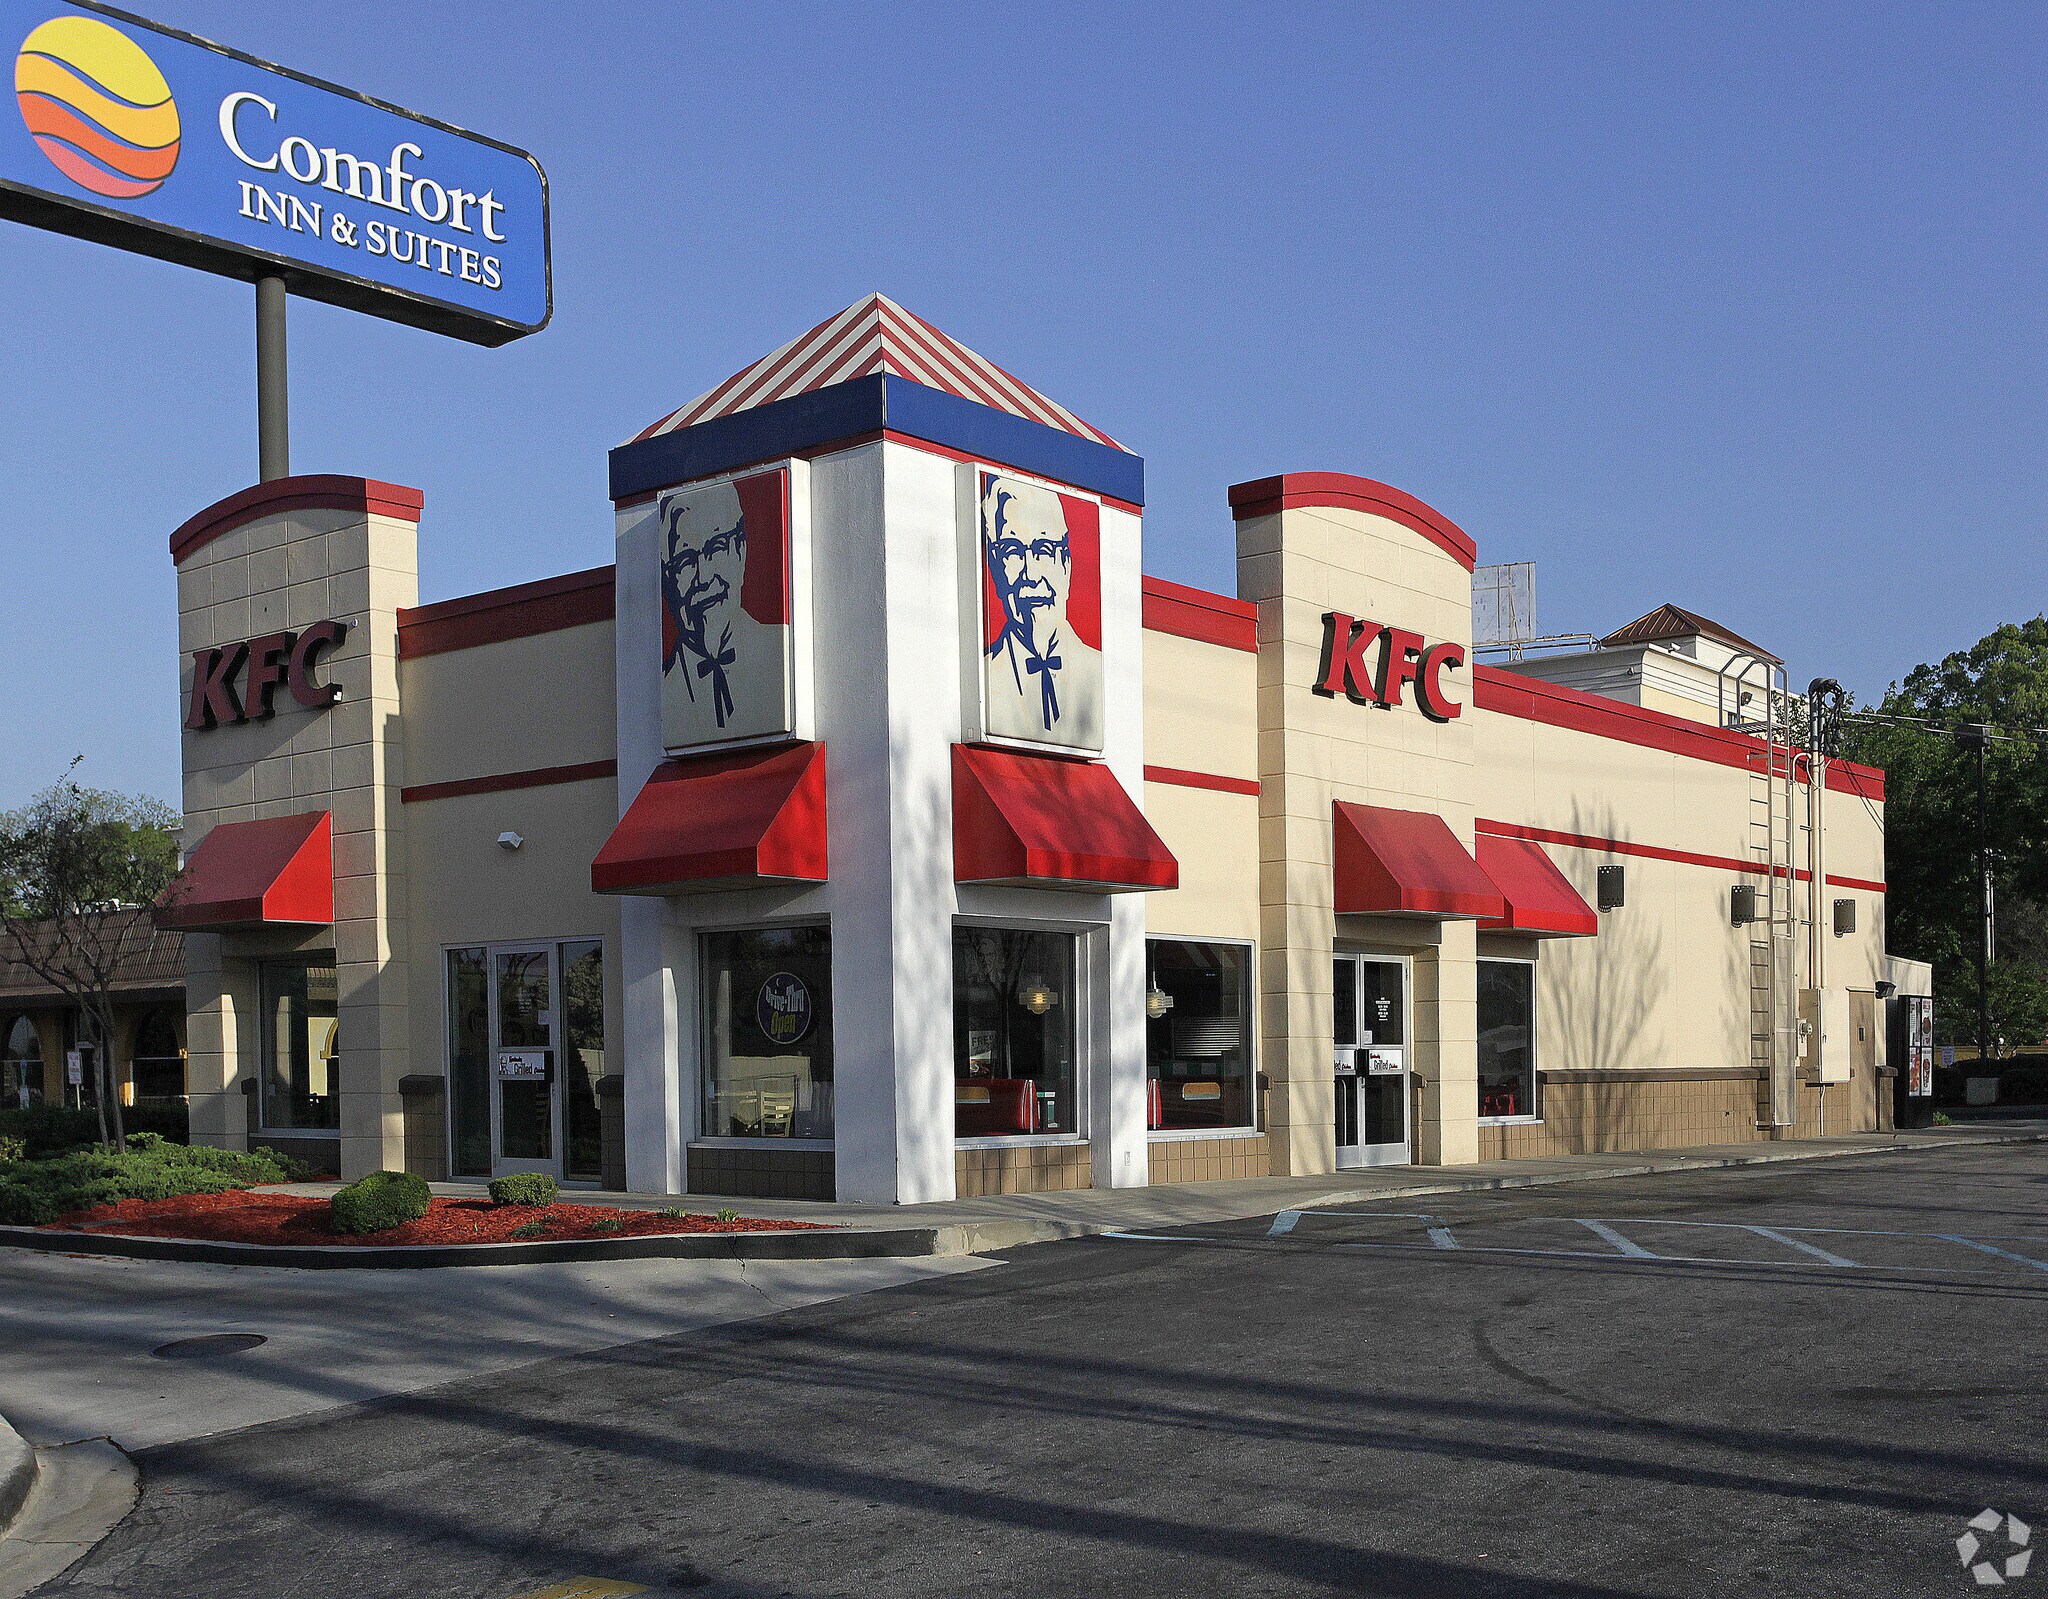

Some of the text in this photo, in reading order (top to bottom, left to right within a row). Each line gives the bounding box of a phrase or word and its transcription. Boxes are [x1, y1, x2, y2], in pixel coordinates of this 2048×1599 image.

[218, 91, 507, 243] Comfort
[237, 180, 503, 290] INN & SUITES
[184, 620, 347, 732] KFC
[1312, 611, 1465, 722] KFC
[771, 1010, 796, 1039] Open
